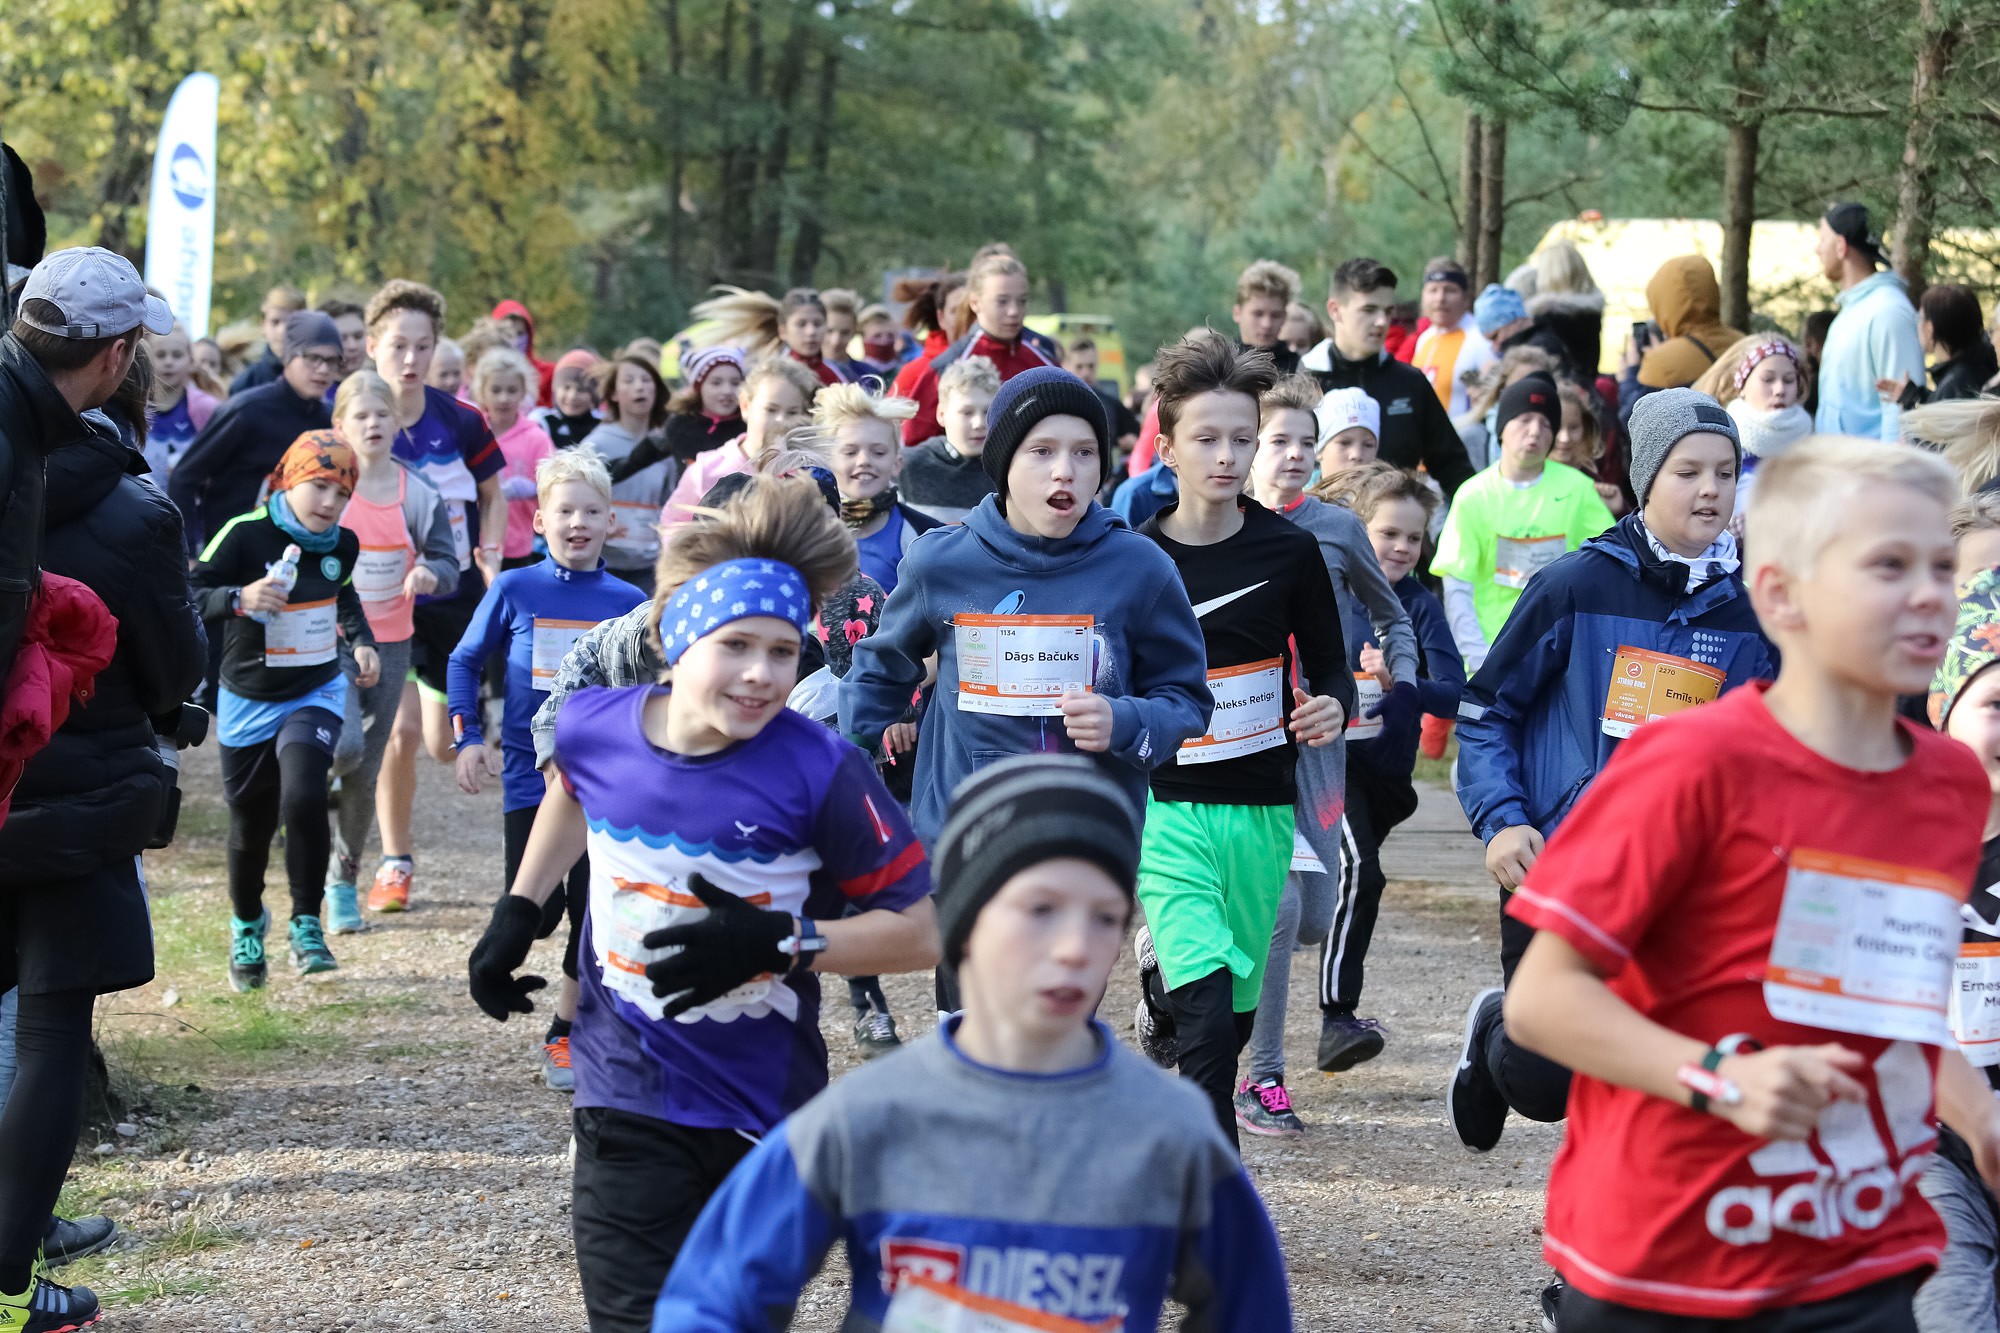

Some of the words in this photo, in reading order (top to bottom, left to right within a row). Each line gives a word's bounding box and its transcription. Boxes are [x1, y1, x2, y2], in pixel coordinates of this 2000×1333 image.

[1005, 651, 1034, 663] Dāgs
[1038, 650, 1080, 662] Bačuks
[1659, 667, 1676, 676] 2270
[1209, 681, 1224, 689] 1241
[1215, 698, 1247, 711] Alekss
[1249, 690, 1275, 705] Retigs
[1665, 688, 1693, 704] Emīls
[967, 1245, 1126, 1316] DIESEL
